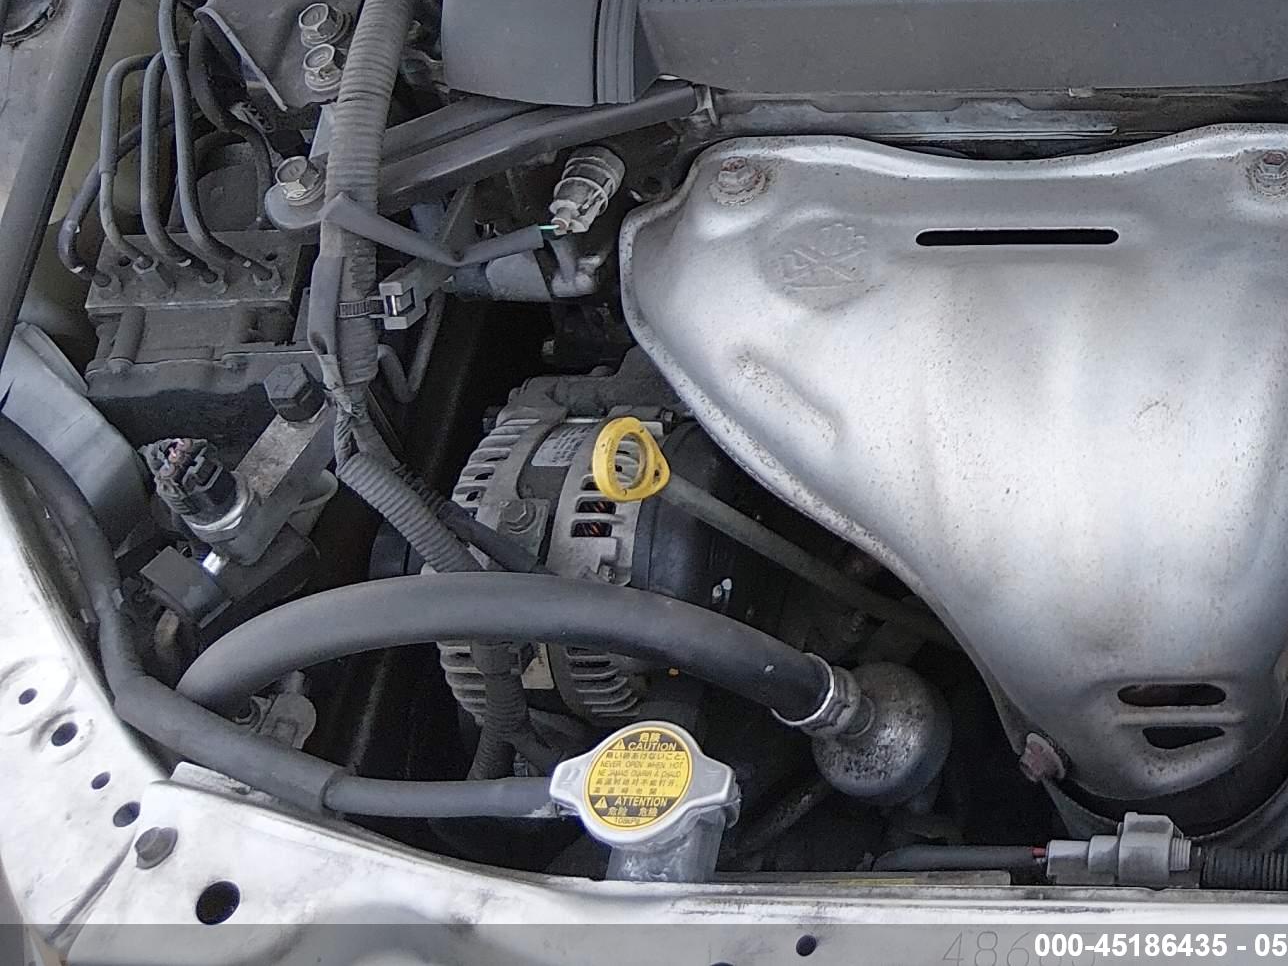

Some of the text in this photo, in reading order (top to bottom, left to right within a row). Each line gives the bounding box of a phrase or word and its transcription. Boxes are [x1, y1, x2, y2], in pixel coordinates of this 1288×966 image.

[628, 742, 677, 751] CAUTION
[600, 761, 621, 769] NEVER
[625, 761, 643, 769] OPEN
[669, 762, 684, 770] HOT
[614, 797, 668, 807] ATTENTION
